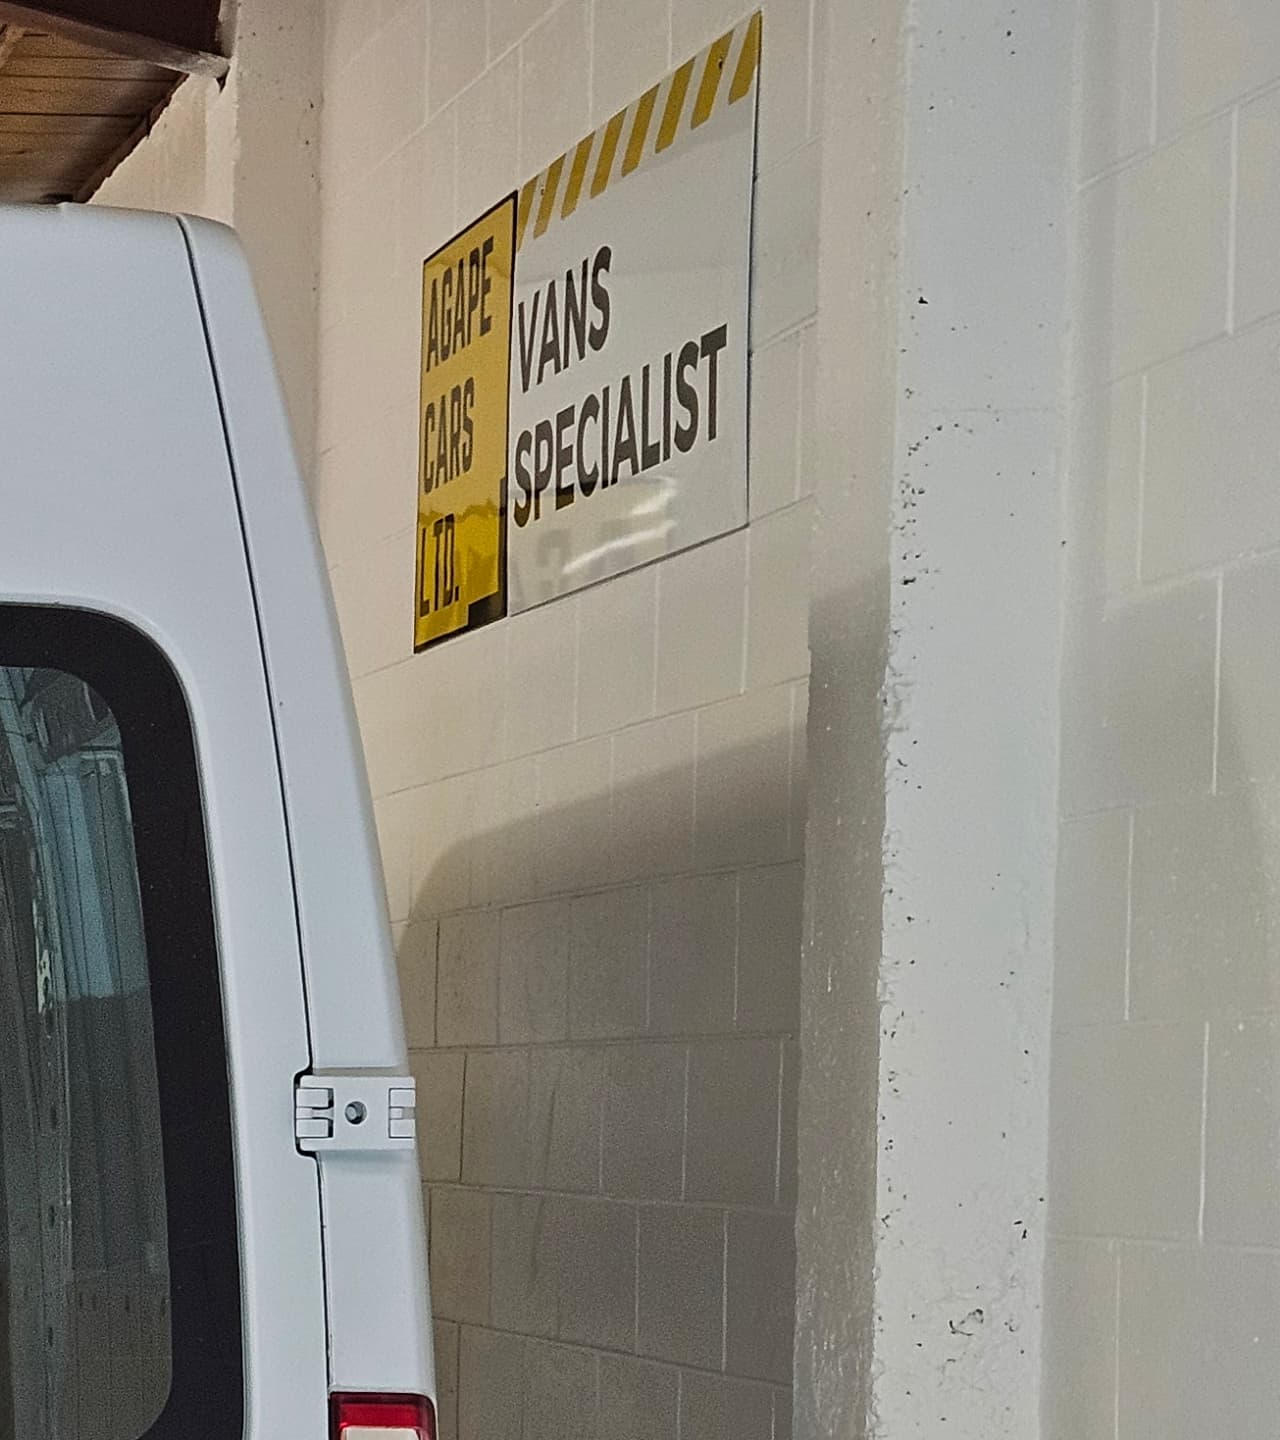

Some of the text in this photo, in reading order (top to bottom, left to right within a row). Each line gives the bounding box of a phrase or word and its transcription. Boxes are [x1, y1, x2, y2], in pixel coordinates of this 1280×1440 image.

[426, 236, 494, 372] AGAPE
[518, 245, 611, 394] VANS
[423, 376, 474, 495] CARS
[512, 323, 728, 528] SPECIALIST
[419, 512, 460, 619] LTD.
